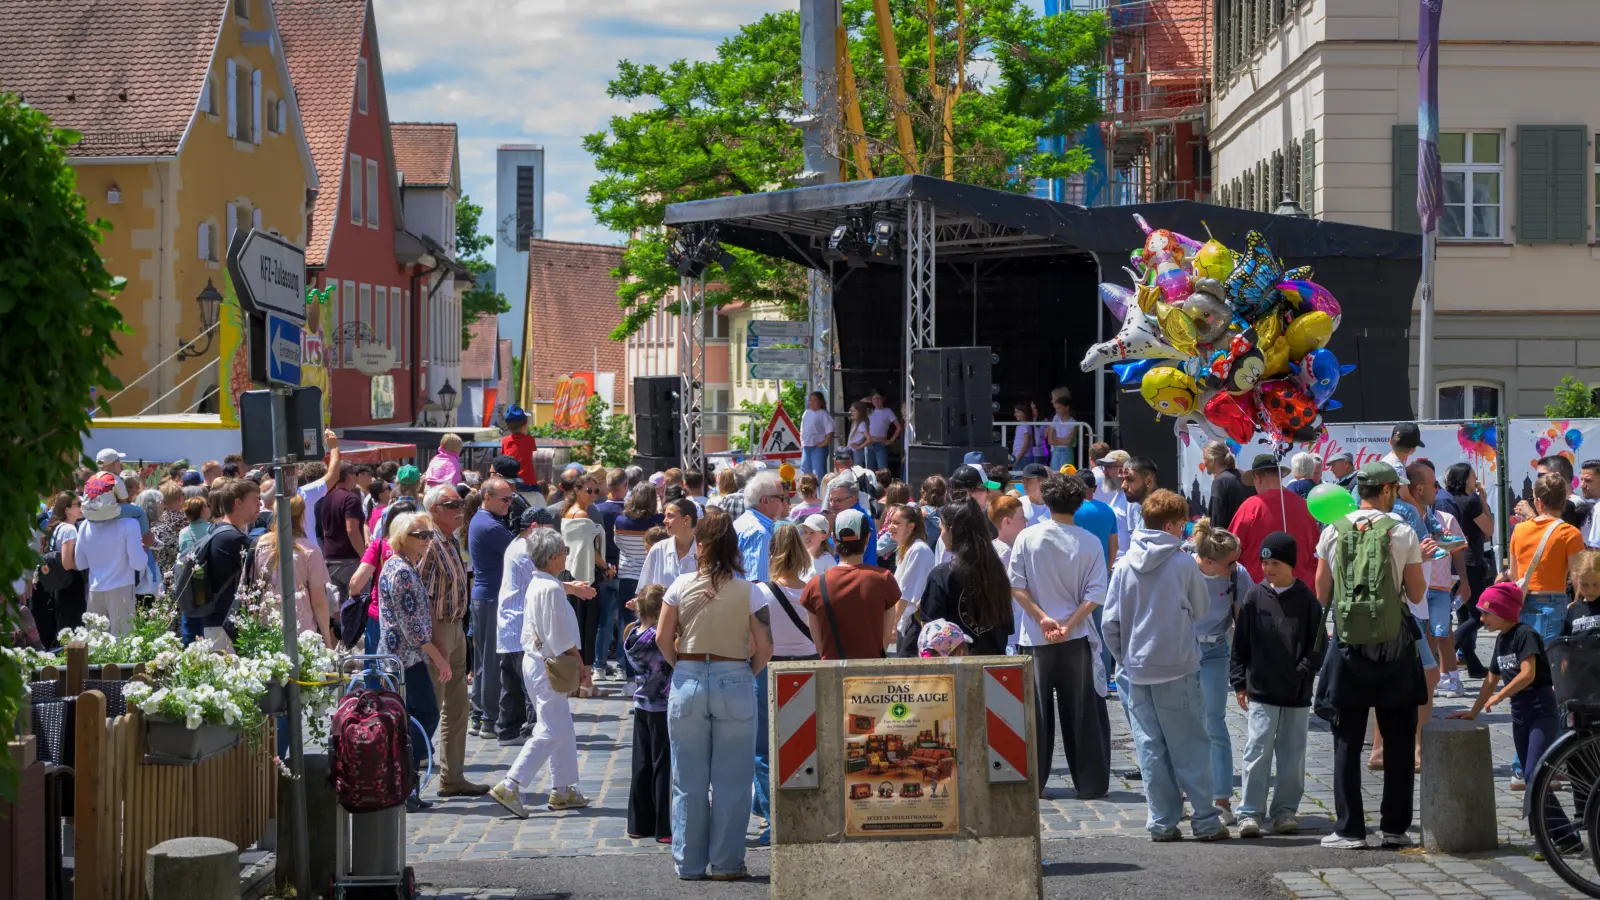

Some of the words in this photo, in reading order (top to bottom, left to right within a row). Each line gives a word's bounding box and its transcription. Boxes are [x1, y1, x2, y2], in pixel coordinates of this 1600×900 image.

[260, 254, 299, 299] KFZ-Zulassung
[887, 685, 910, 694] DAS
[851, 694, 915, 705] MAGISCHE
[916, 693, 948, 702] AUGE
